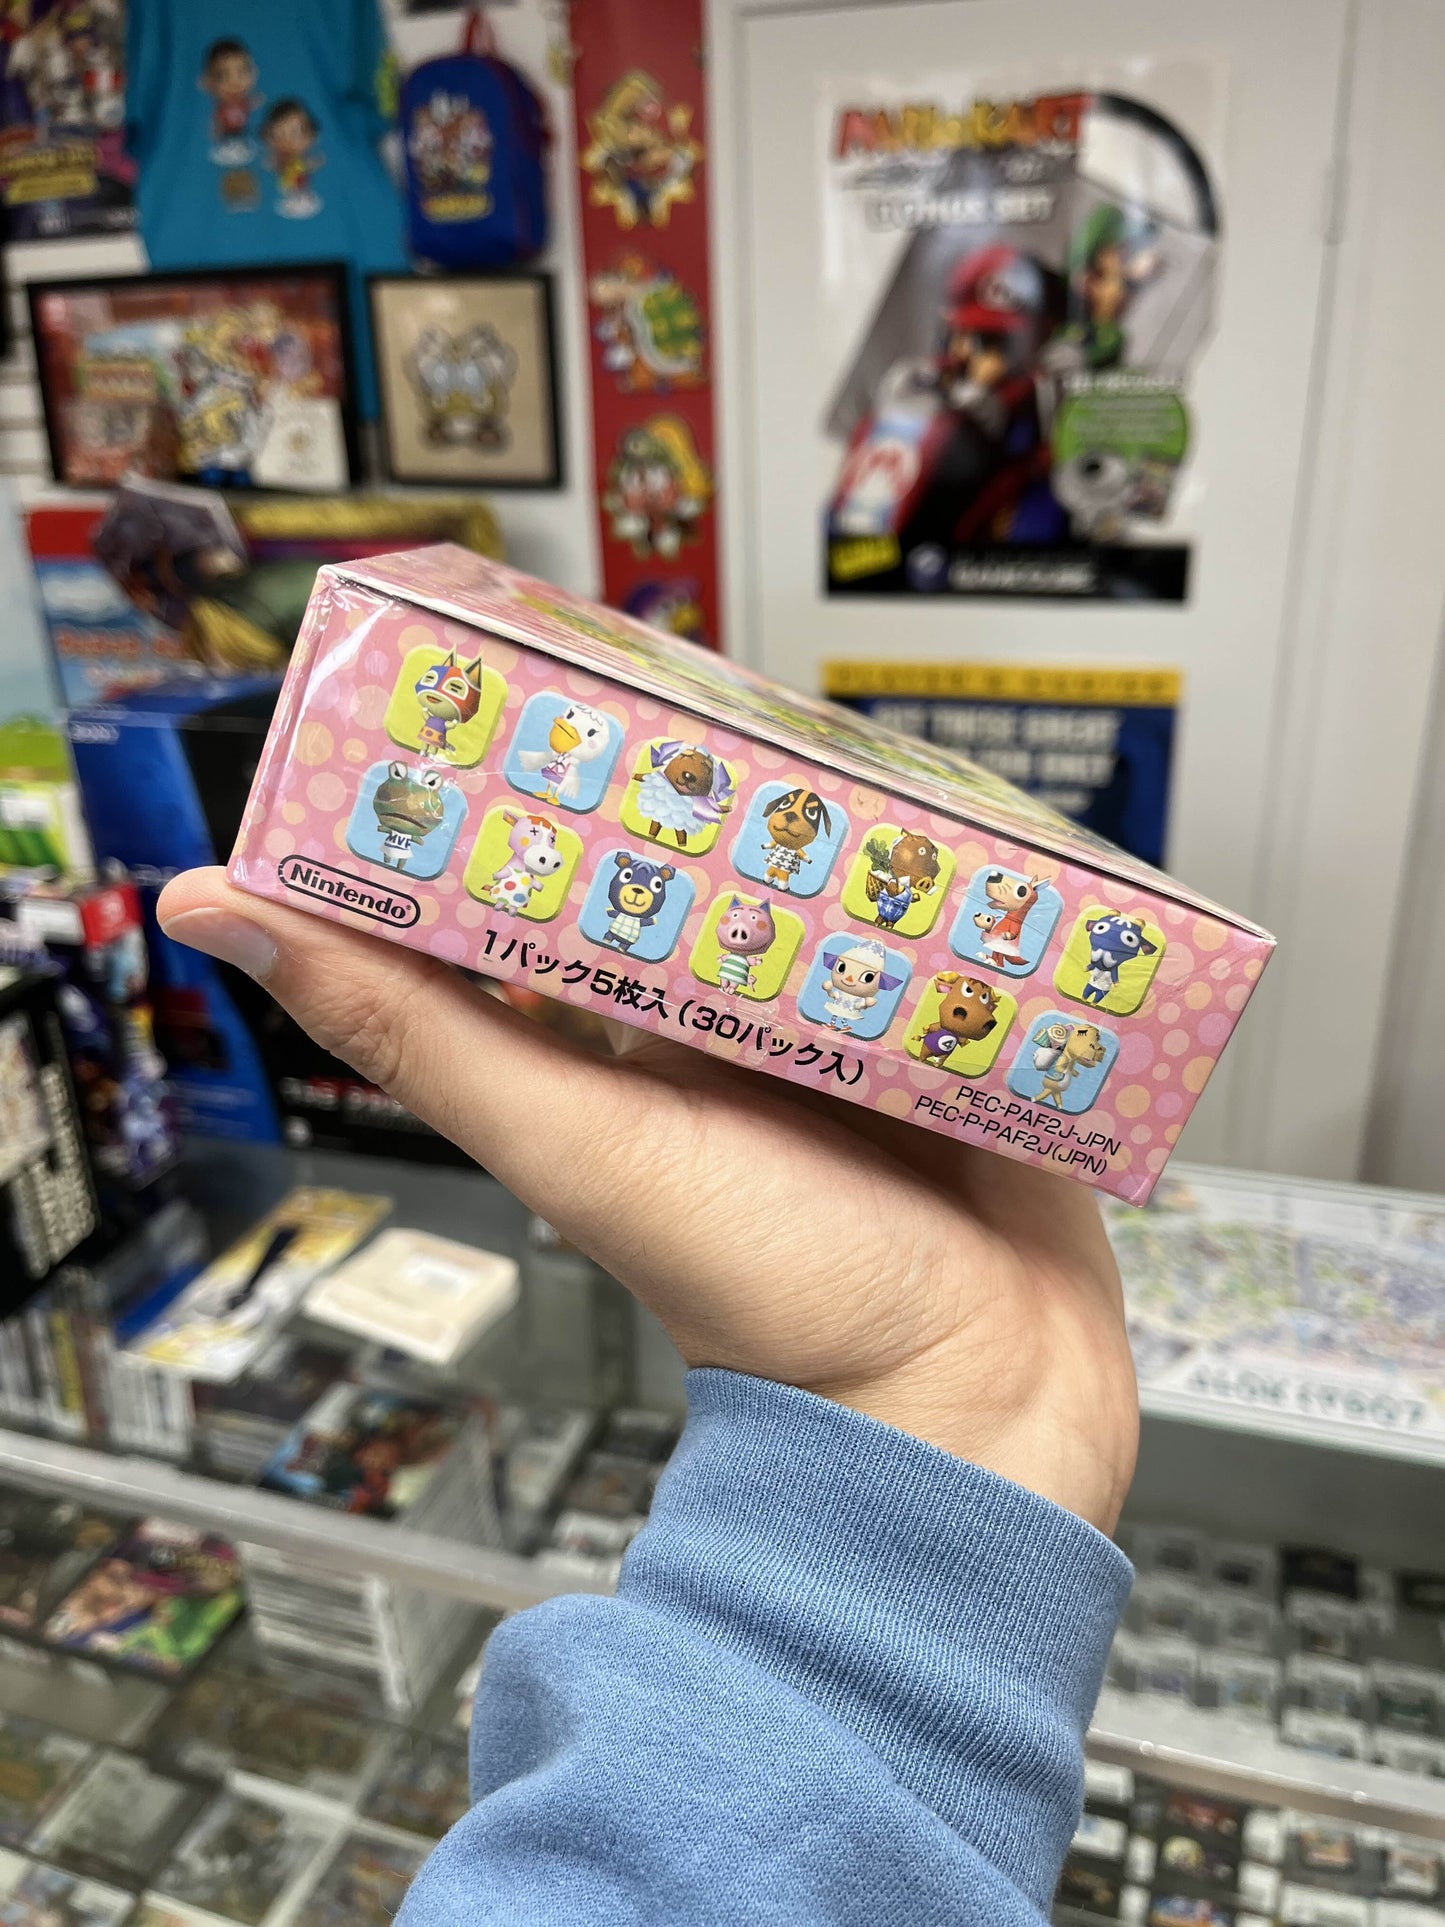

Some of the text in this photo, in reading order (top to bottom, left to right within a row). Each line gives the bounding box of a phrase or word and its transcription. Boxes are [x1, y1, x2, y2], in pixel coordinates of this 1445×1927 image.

[289, 863, 407, 920] Nintendo
[941, 1039, 954, 1050] 4
[914, 1095, 1107, 1176] PEC-P-PAF2J(JPN)
[956, 1085, 1121, 1156] PEC-PAF2J-JPN
